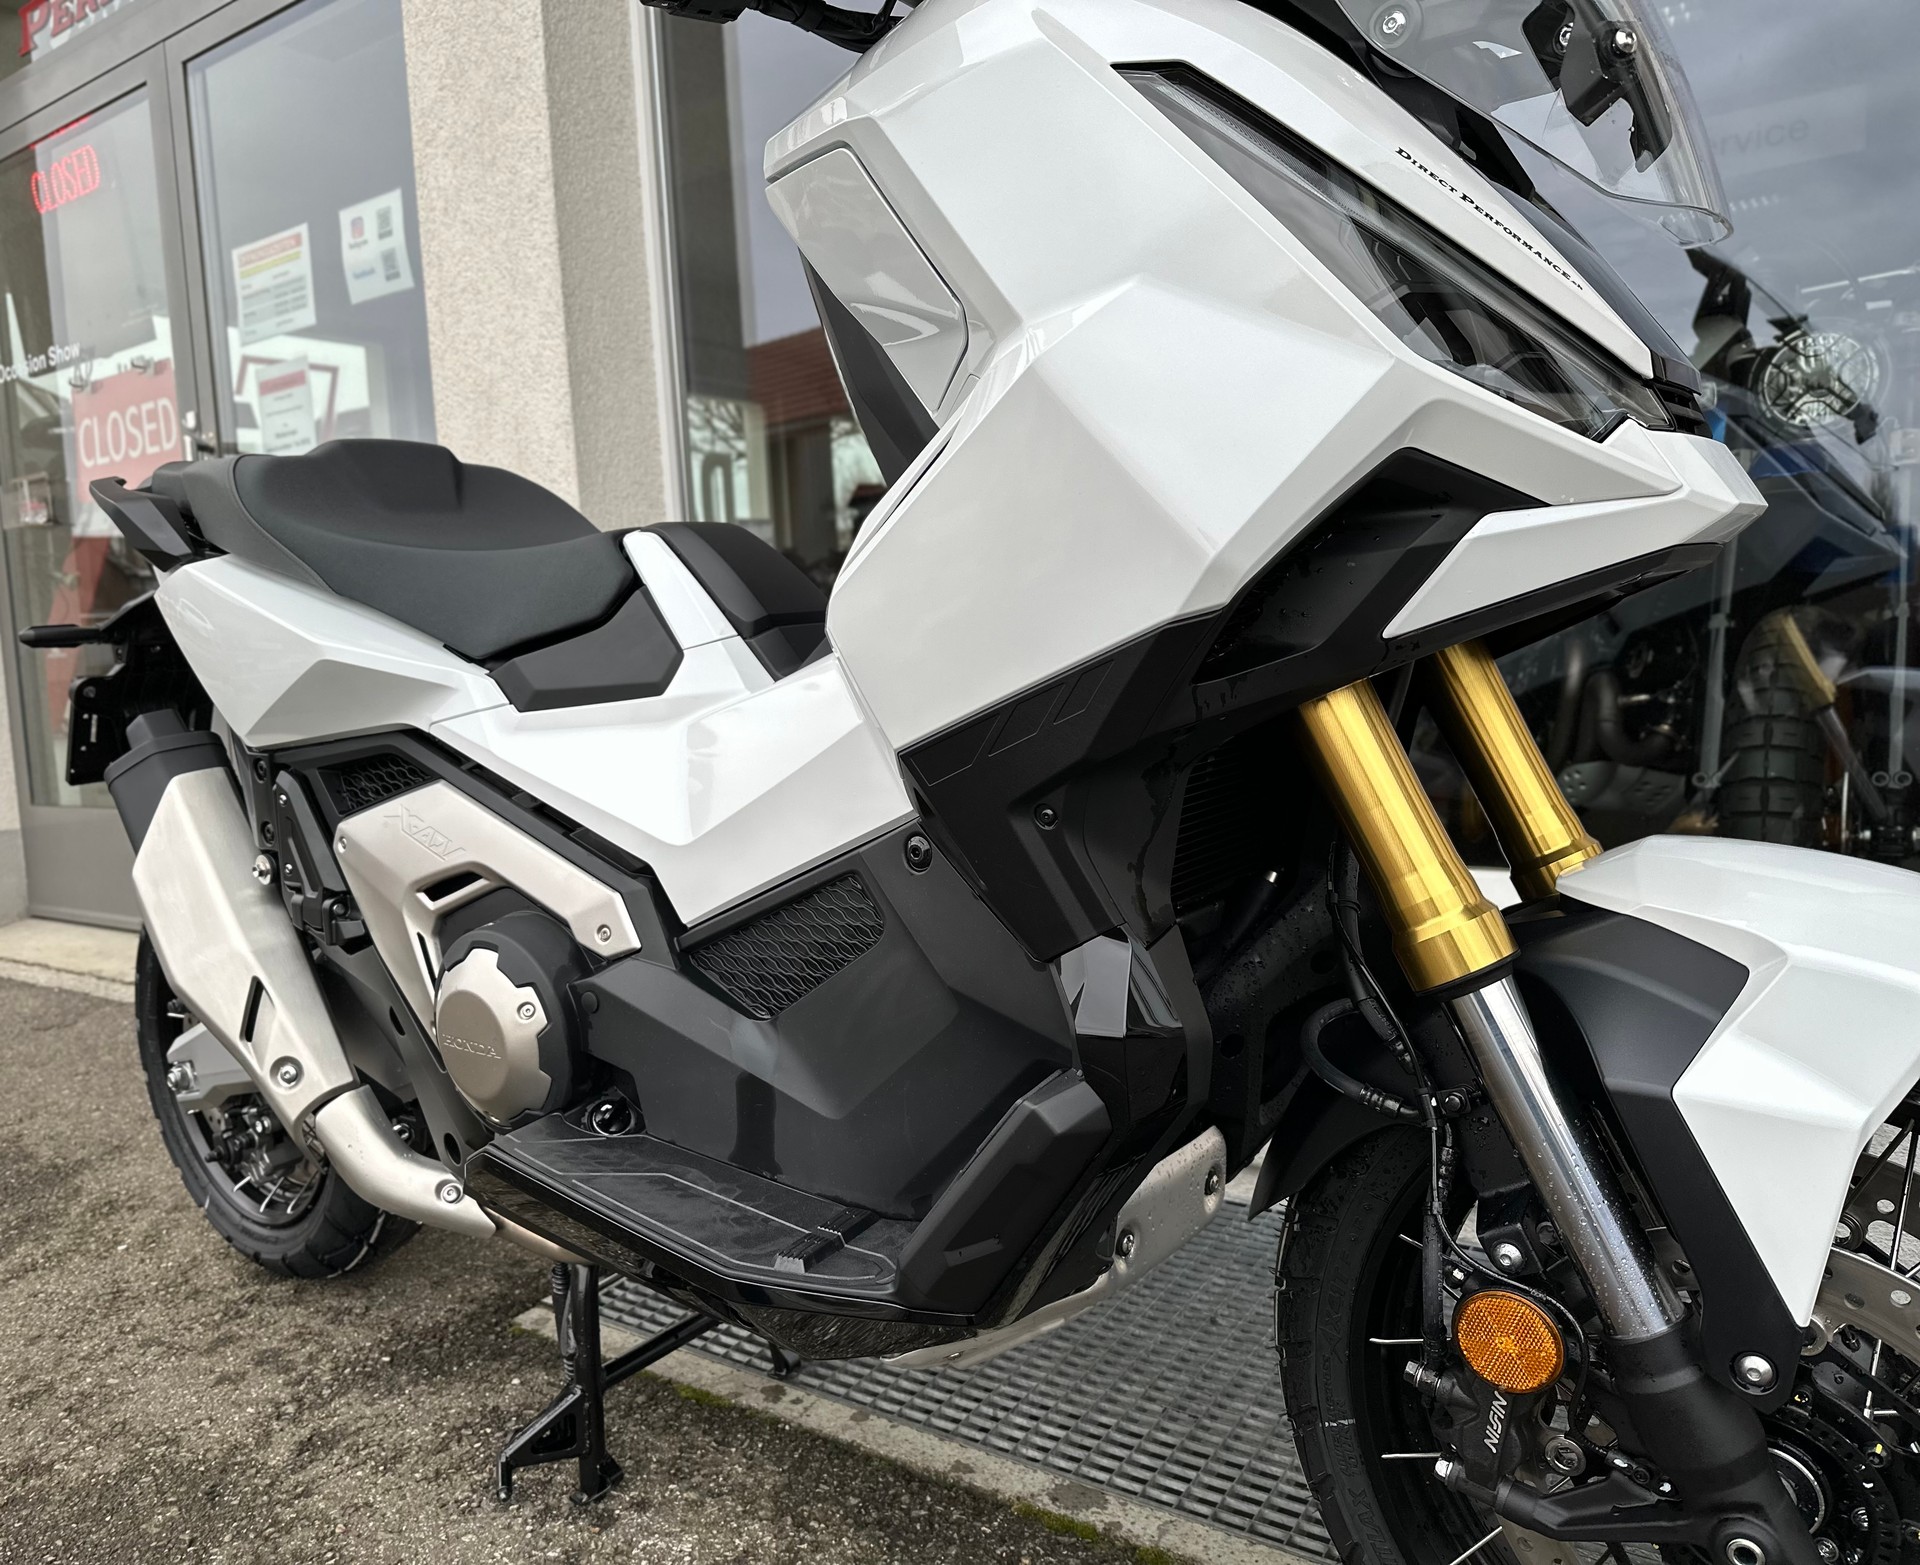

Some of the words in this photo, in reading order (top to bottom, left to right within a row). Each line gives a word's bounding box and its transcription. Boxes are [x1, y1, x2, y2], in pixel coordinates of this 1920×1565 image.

[1711, 117, 1810, 157] rvice
[30, 144, 101, 214] CLOSED
[1394, 146, 1458, 194] DIRECT
[0, 352, 47, 384] Occion
[47, 342, 80, 368] Show
[78, 396, 178, 469] CLOSED
[442, 1033, 502, 1060] HONDA
[1483, 1390, 1507, 1454] NISSIN
